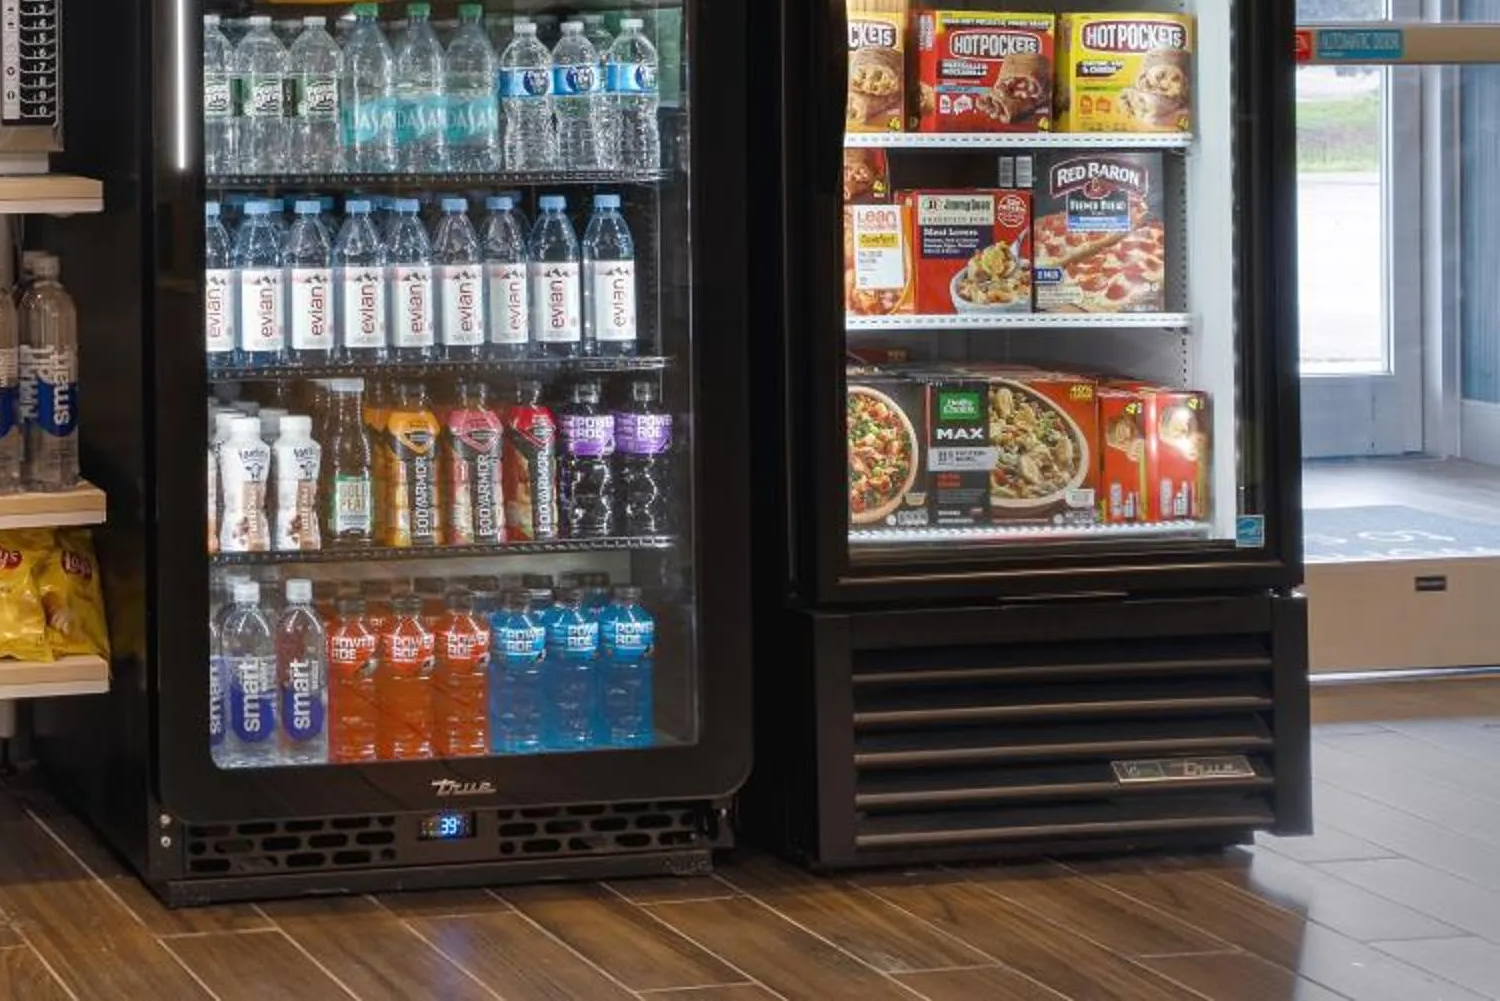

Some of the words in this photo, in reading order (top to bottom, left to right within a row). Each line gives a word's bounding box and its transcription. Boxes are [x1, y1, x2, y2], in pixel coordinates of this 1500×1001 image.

[1057, 167, 1085, 187] RED
[1087, 162, 1140, 187] BARON
[207, 287, 221, 338] evian
[259, 288, 273, 338] evian
[308, 285, 324, 336] evian
[359, 283, 376, 334] evian
[409, 283, 423, 334] evian
[458, 282, 472, 332] evian
[508, 282, 523, 330] evian
[551, 280, 565, 329] evian
[613, 278, 627, 327] evian
[936, 427, 985, 440] MAX
[240, 655, 260, 732] smart
[290, 659, 311, 730] smart
[429, 778, 497, 797] True
